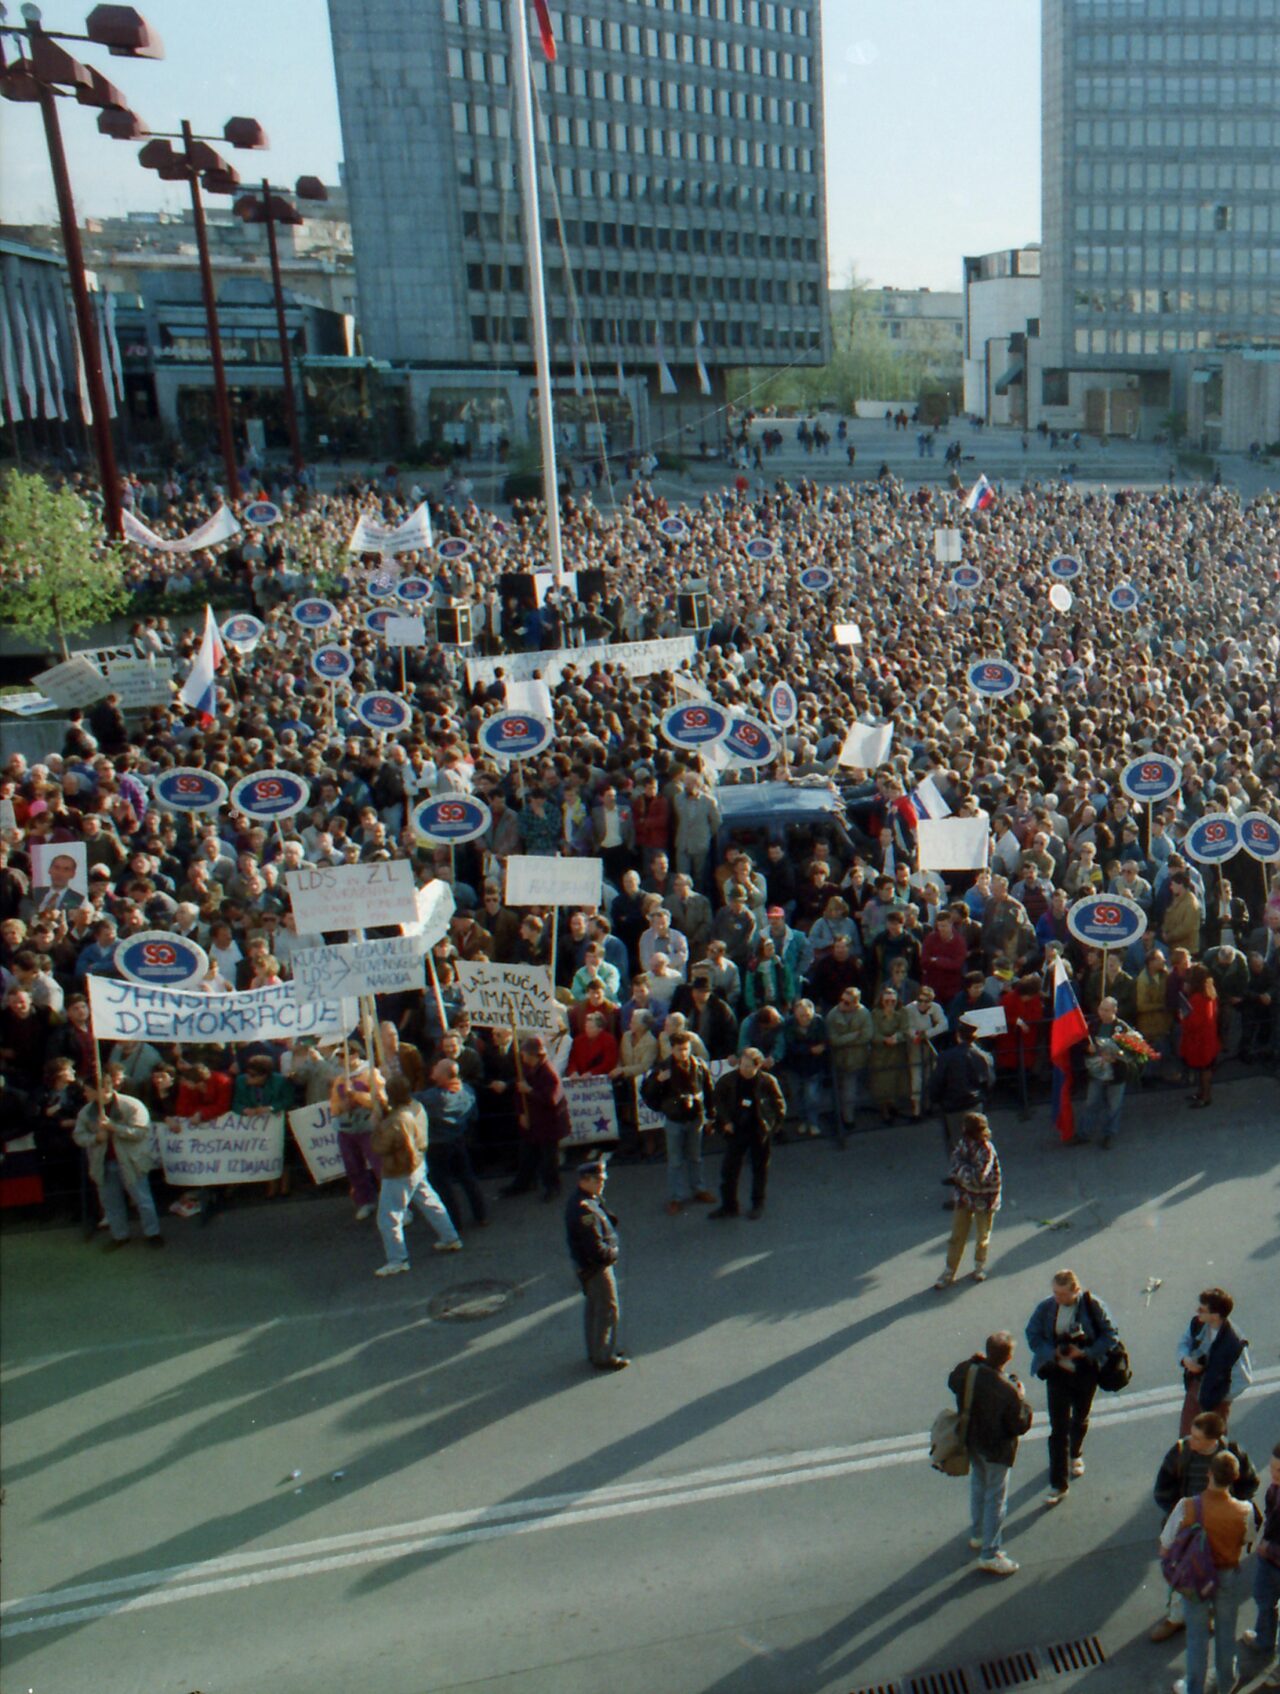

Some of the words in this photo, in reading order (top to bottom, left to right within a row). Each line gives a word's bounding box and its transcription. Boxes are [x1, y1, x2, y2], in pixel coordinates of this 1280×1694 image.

[298, 869, 337, 891] LDS
[367, 863, 400, 884] ZL
[302, 966, 332, 986] LDS
[479, 989, 535, 1010] IMATA
[114, 998, 338, 1037] DEMOKRACIJE
[519, 1009, 553, 1029] NOGE
